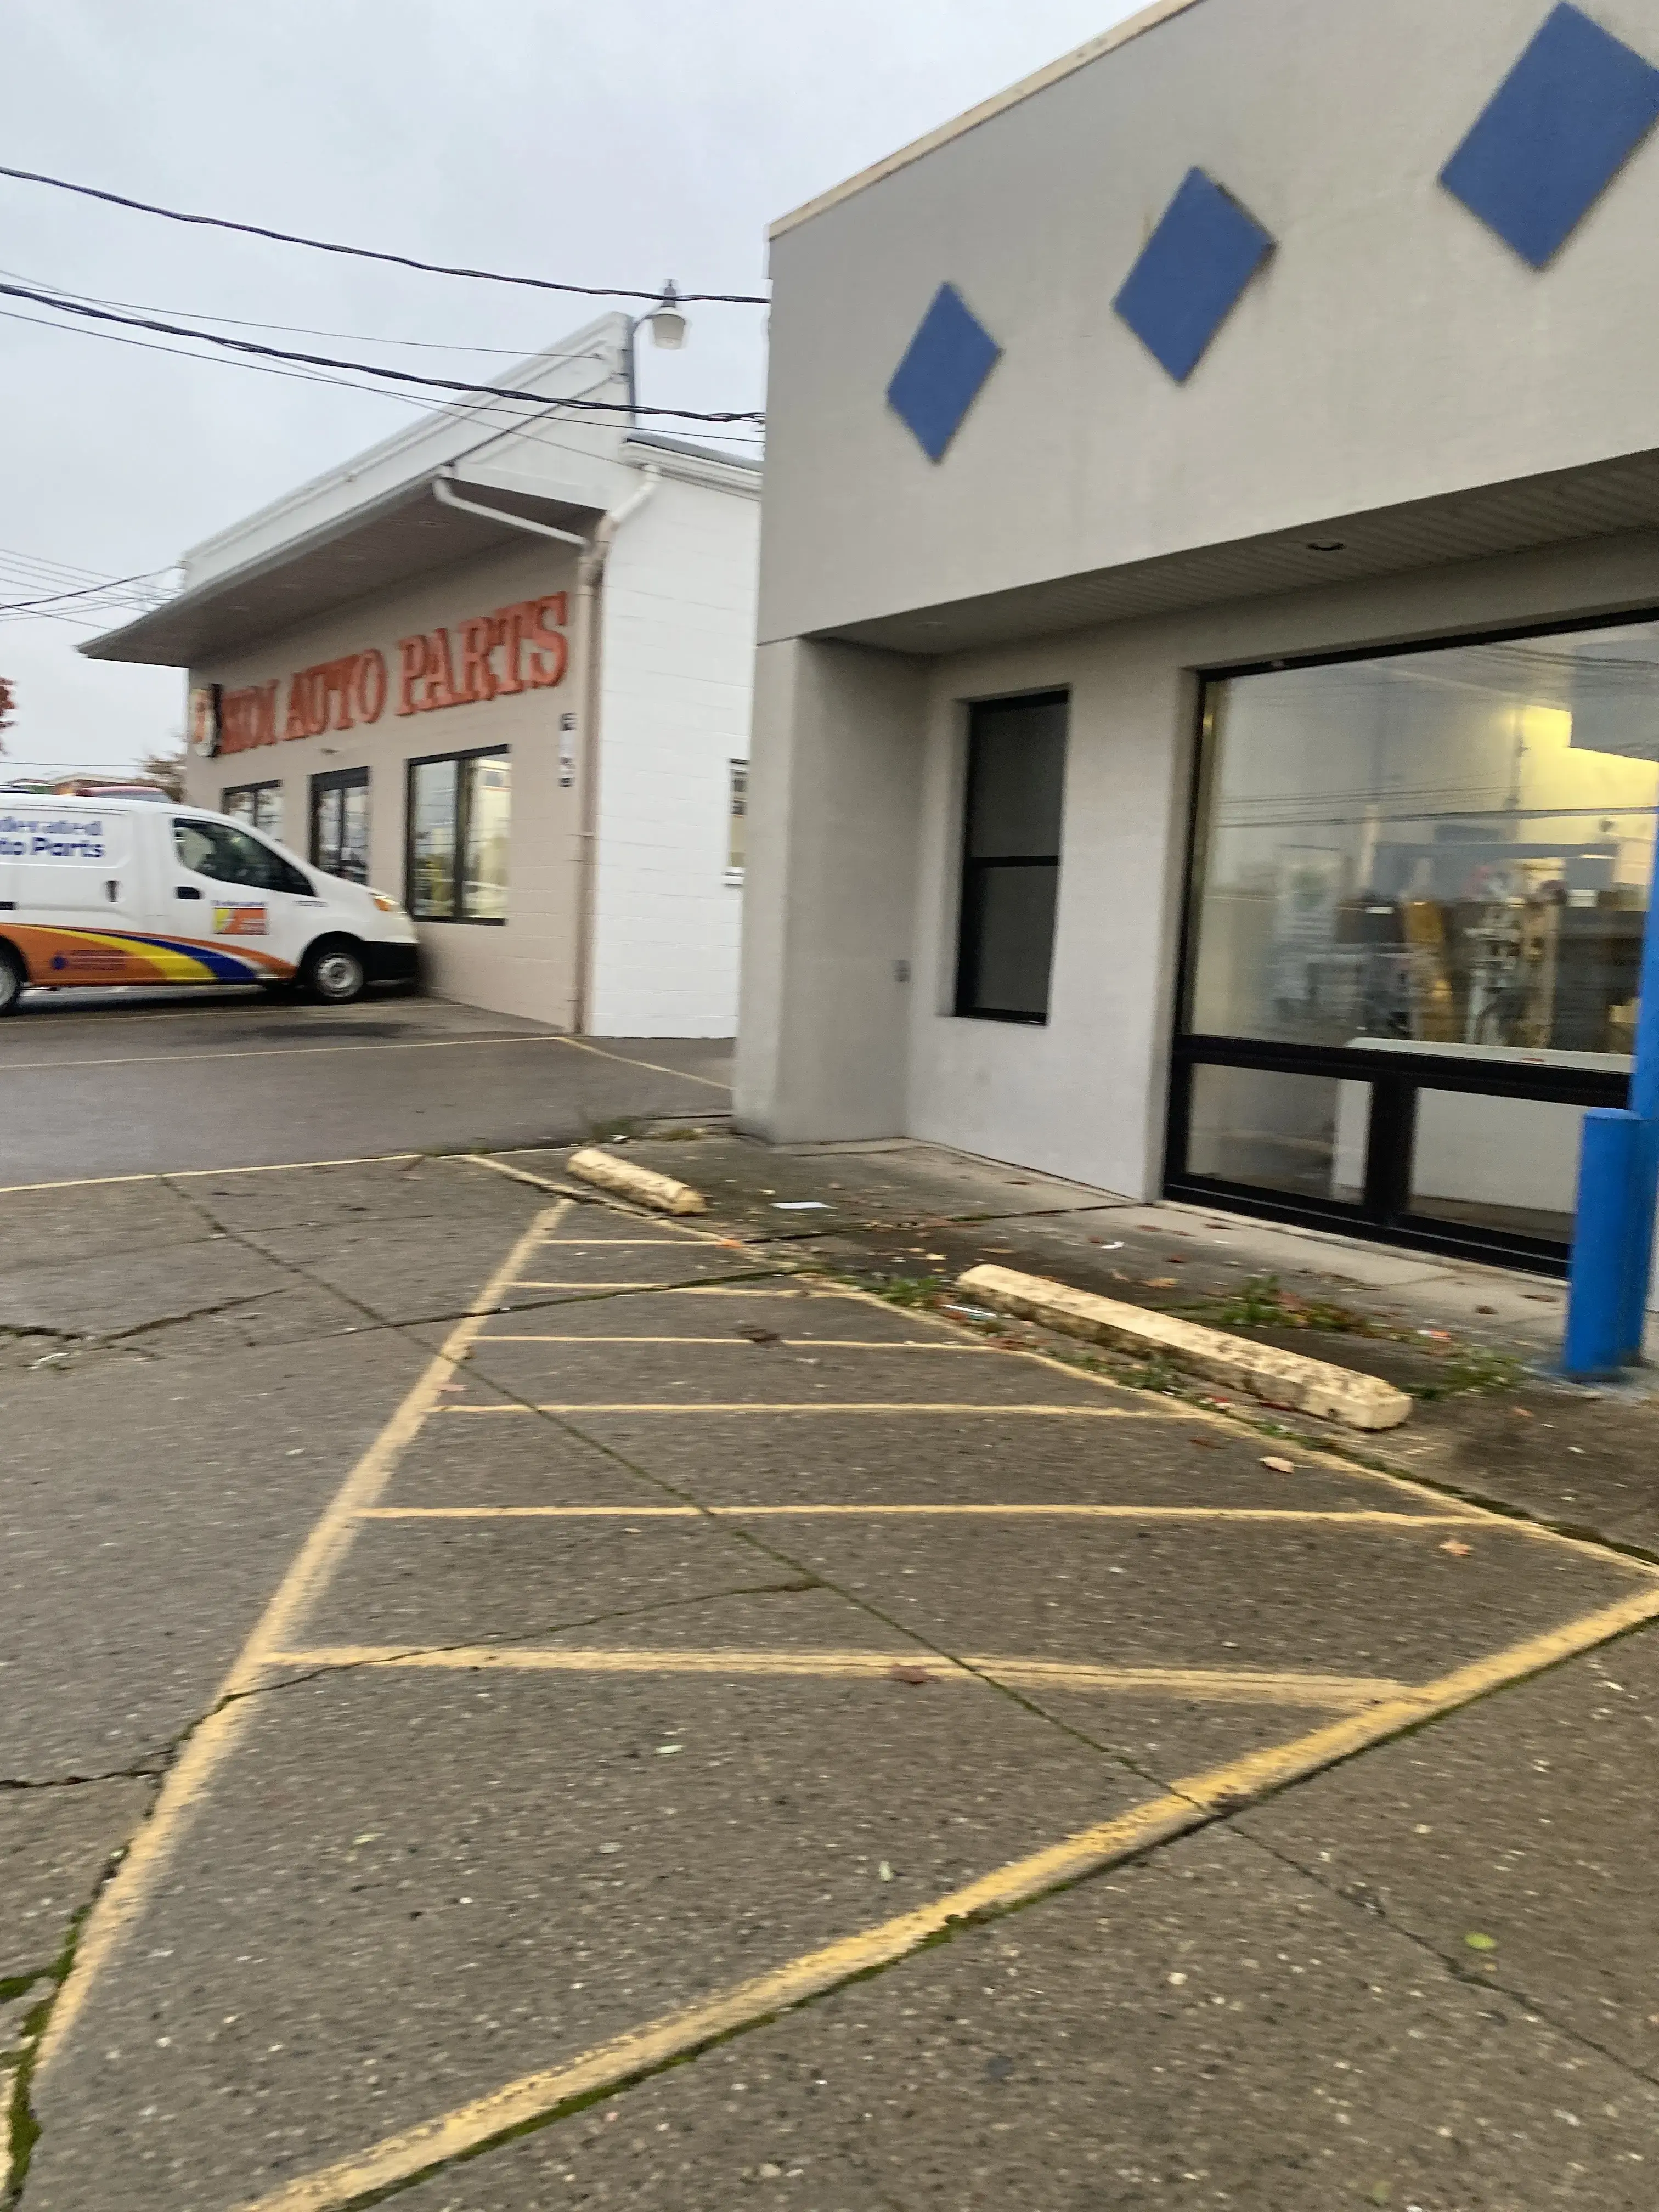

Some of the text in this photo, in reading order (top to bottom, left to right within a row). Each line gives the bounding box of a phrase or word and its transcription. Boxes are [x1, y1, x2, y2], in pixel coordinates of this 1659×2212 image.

[280, 648, 388, 741] AUTO
[395, 591, 569, 716] PARTS
[30, 837, 105, 857] Parts
